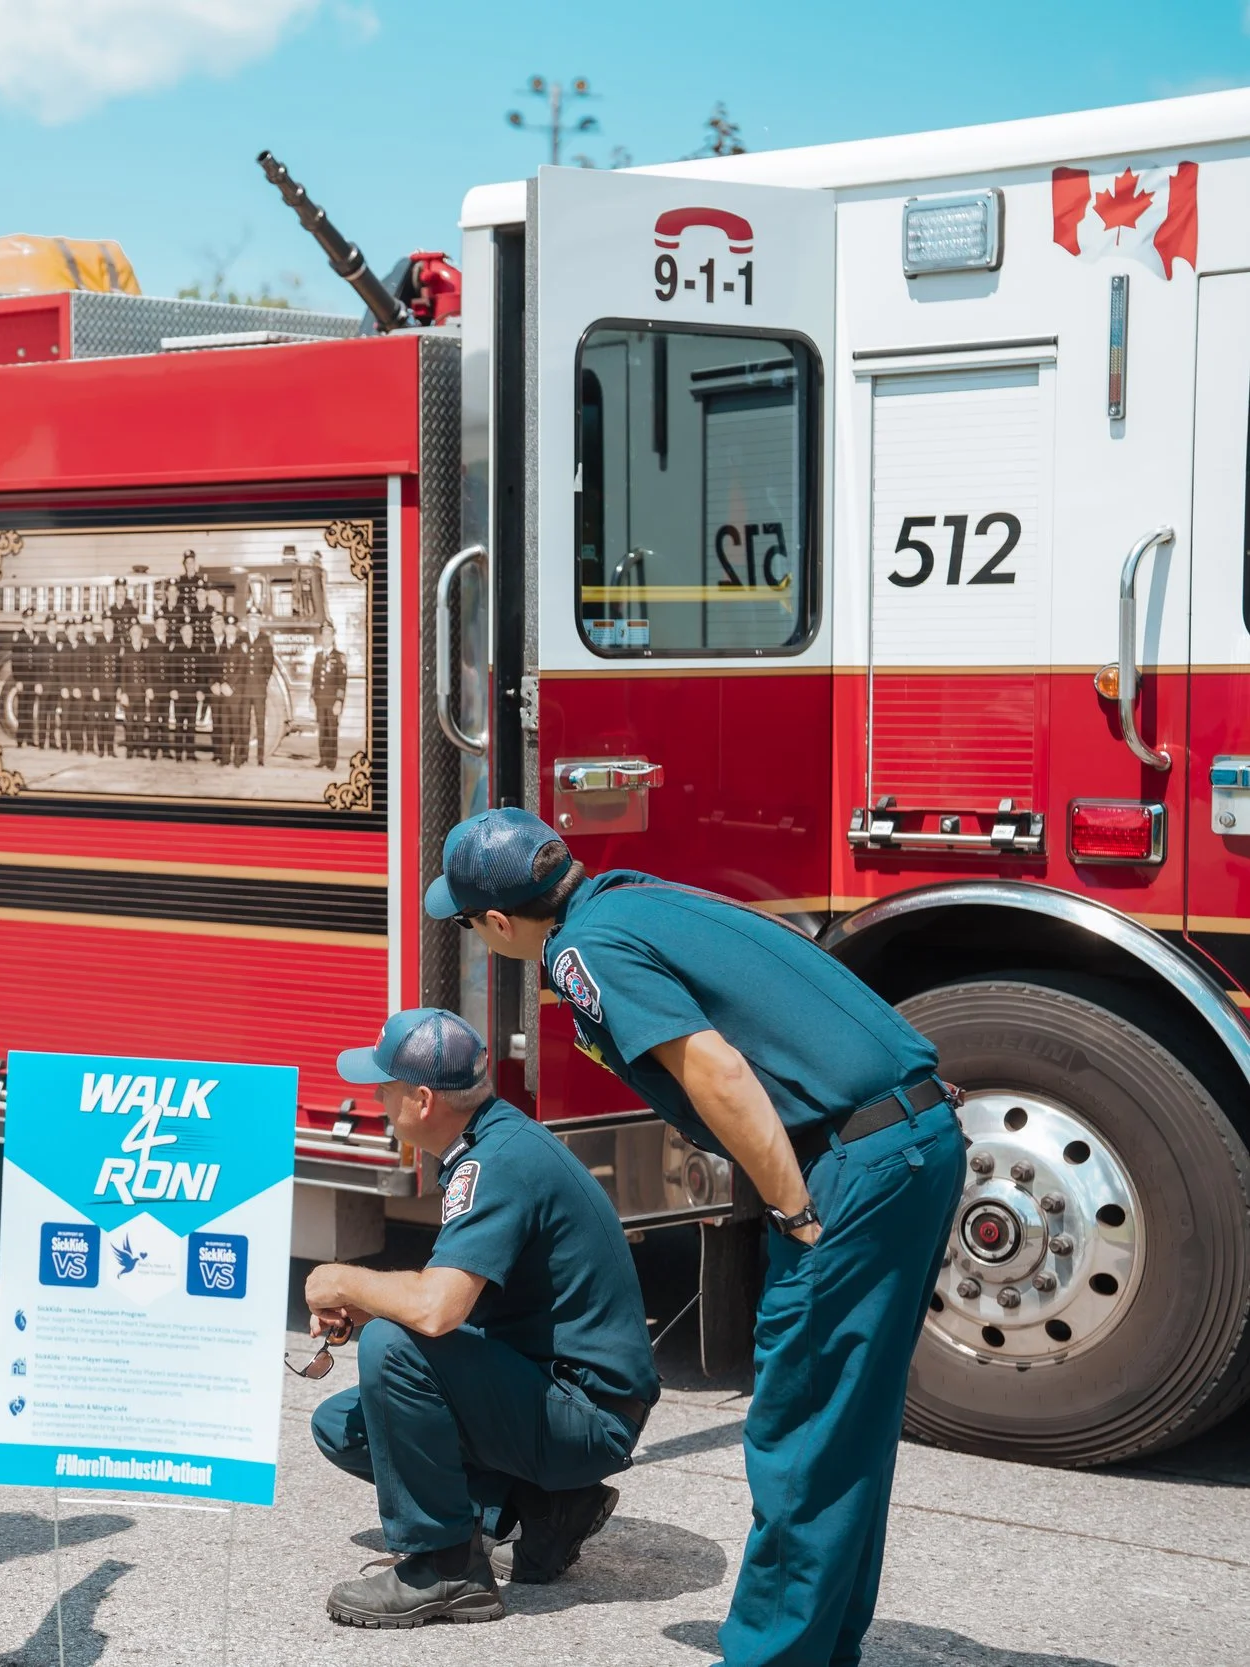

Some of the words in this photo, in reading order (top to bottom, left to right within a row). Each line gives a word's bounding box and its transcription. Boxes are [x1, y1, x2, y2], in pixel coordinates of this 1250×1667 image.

[654, 253, 753, 306] 9-1-1
[887, 511, 1022, 588] 512
[943, 1031, 1070, 1062] ICHELIN
[79, 1072, 221, 1120] WALK
[121, 1103, 178, 1163] 4
[93, 1157, 221, 1206] RONI
[51, 1237, 89, 1253] SickKids
[199, 1247, 236, 1263] SickKids
[52, 1252, 87, 1279] VS
[199, 1262, 235, 1290] VS
[55, 1453, 213, 1487] #MoreThanJustAPatient
